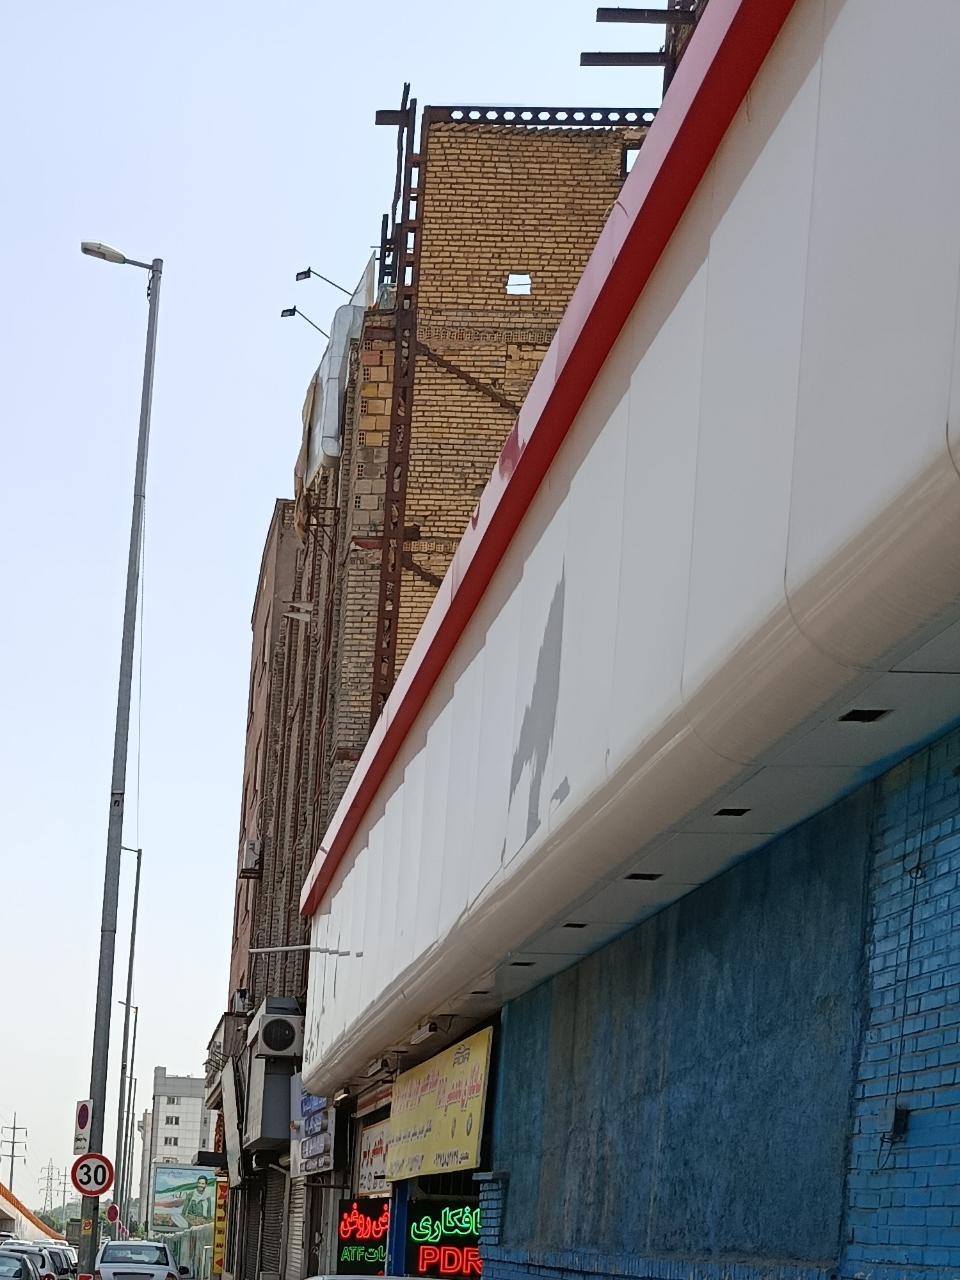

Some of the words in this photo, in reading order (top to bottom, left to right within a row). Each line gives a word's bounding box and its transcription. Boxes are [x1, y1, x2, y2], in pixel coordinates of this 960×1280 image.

[78, 1163, 107, 1186] 30
[340, 1202, 371, 1238] روغن
[411, 1206, 482, 1242] افکاری
[341, 1246, 365, 1262] ATF
[419, 1245, 484, 1275] PDR
